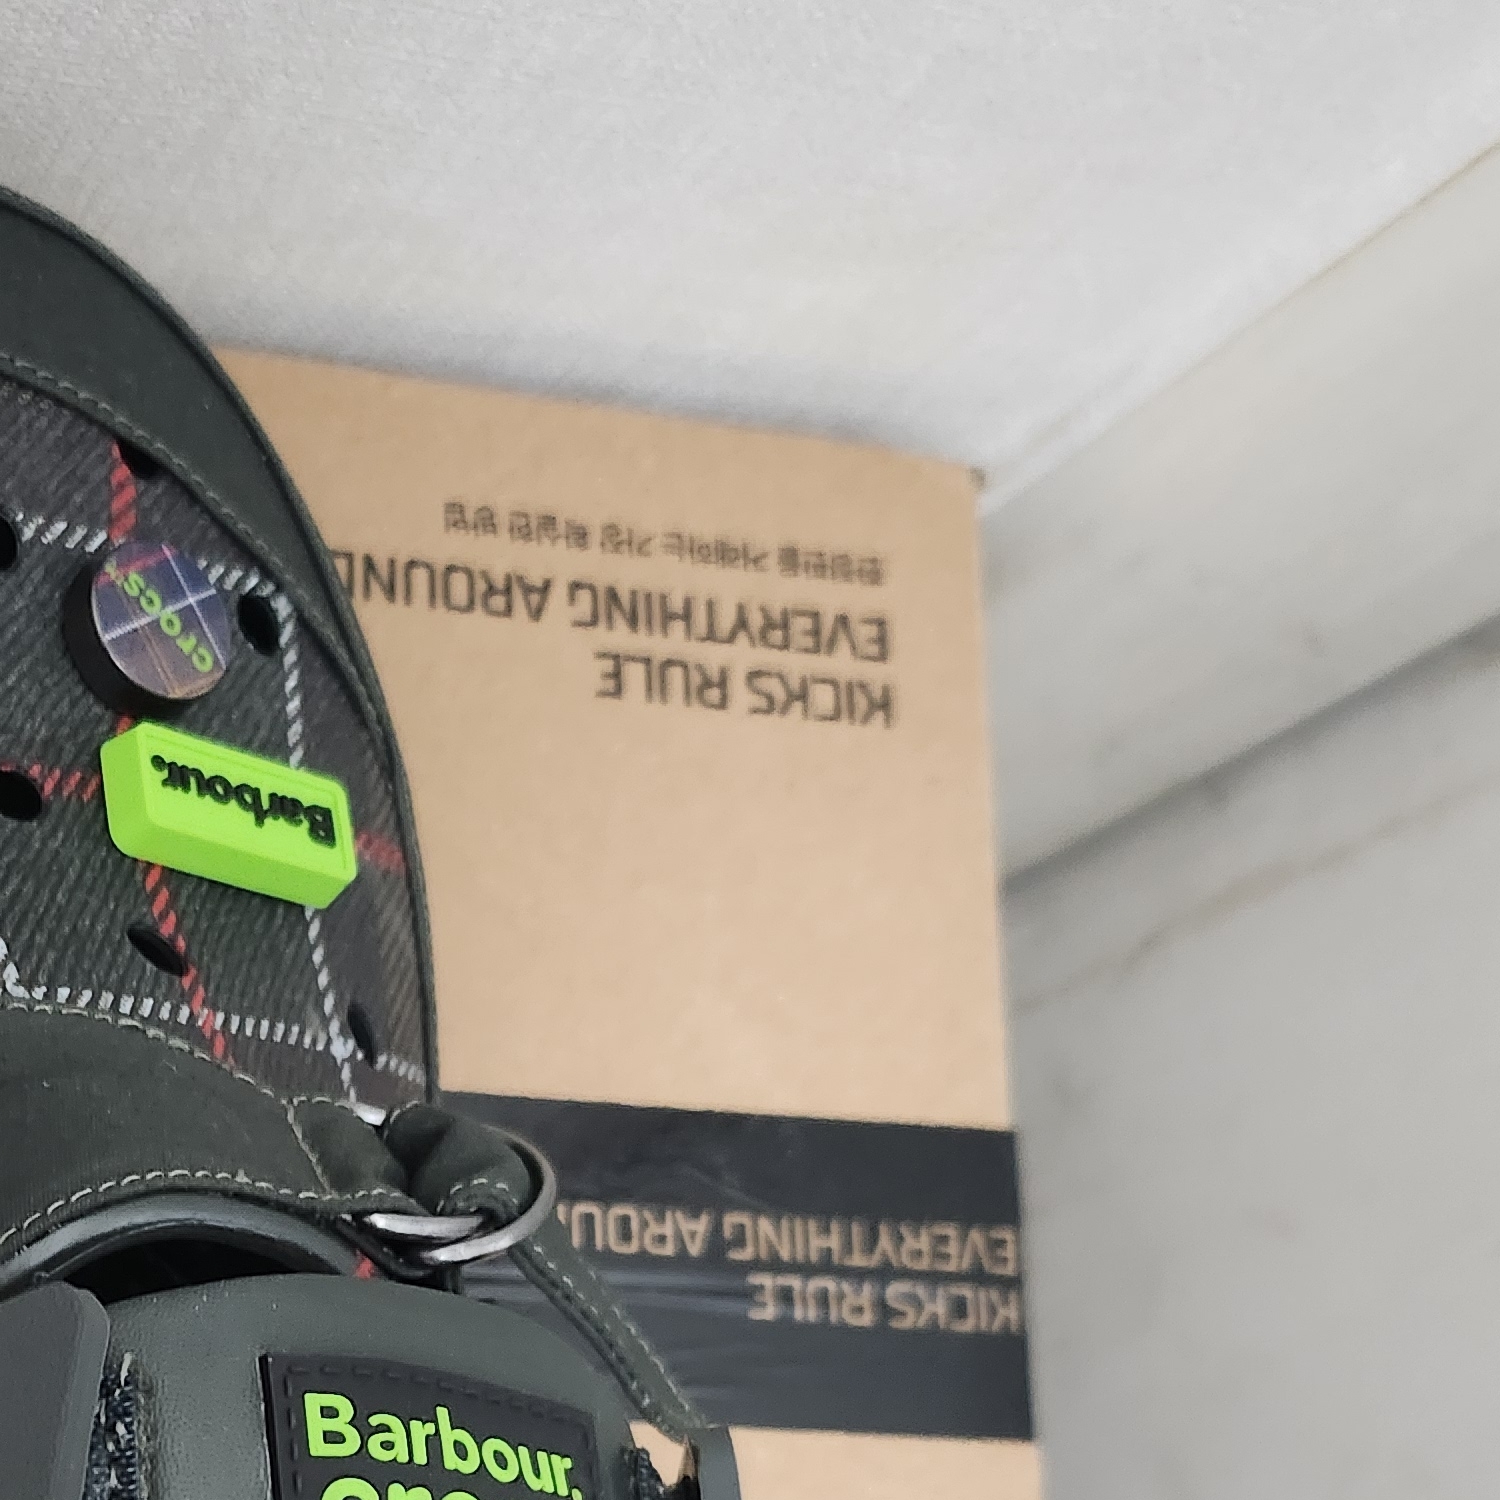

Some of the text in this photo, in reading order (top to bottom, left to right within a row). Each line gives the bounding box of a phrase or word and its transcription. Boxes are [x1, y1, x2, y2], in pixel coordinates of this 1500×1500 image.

[566, 578, 891, 664] EVERYTHING
[594, 650, 894, 729] KICKS RULE
[556, 1200, 1021, 1277] EVERYTHING AROU
[745, 1270, 1023, 1334] KICKS RULE
